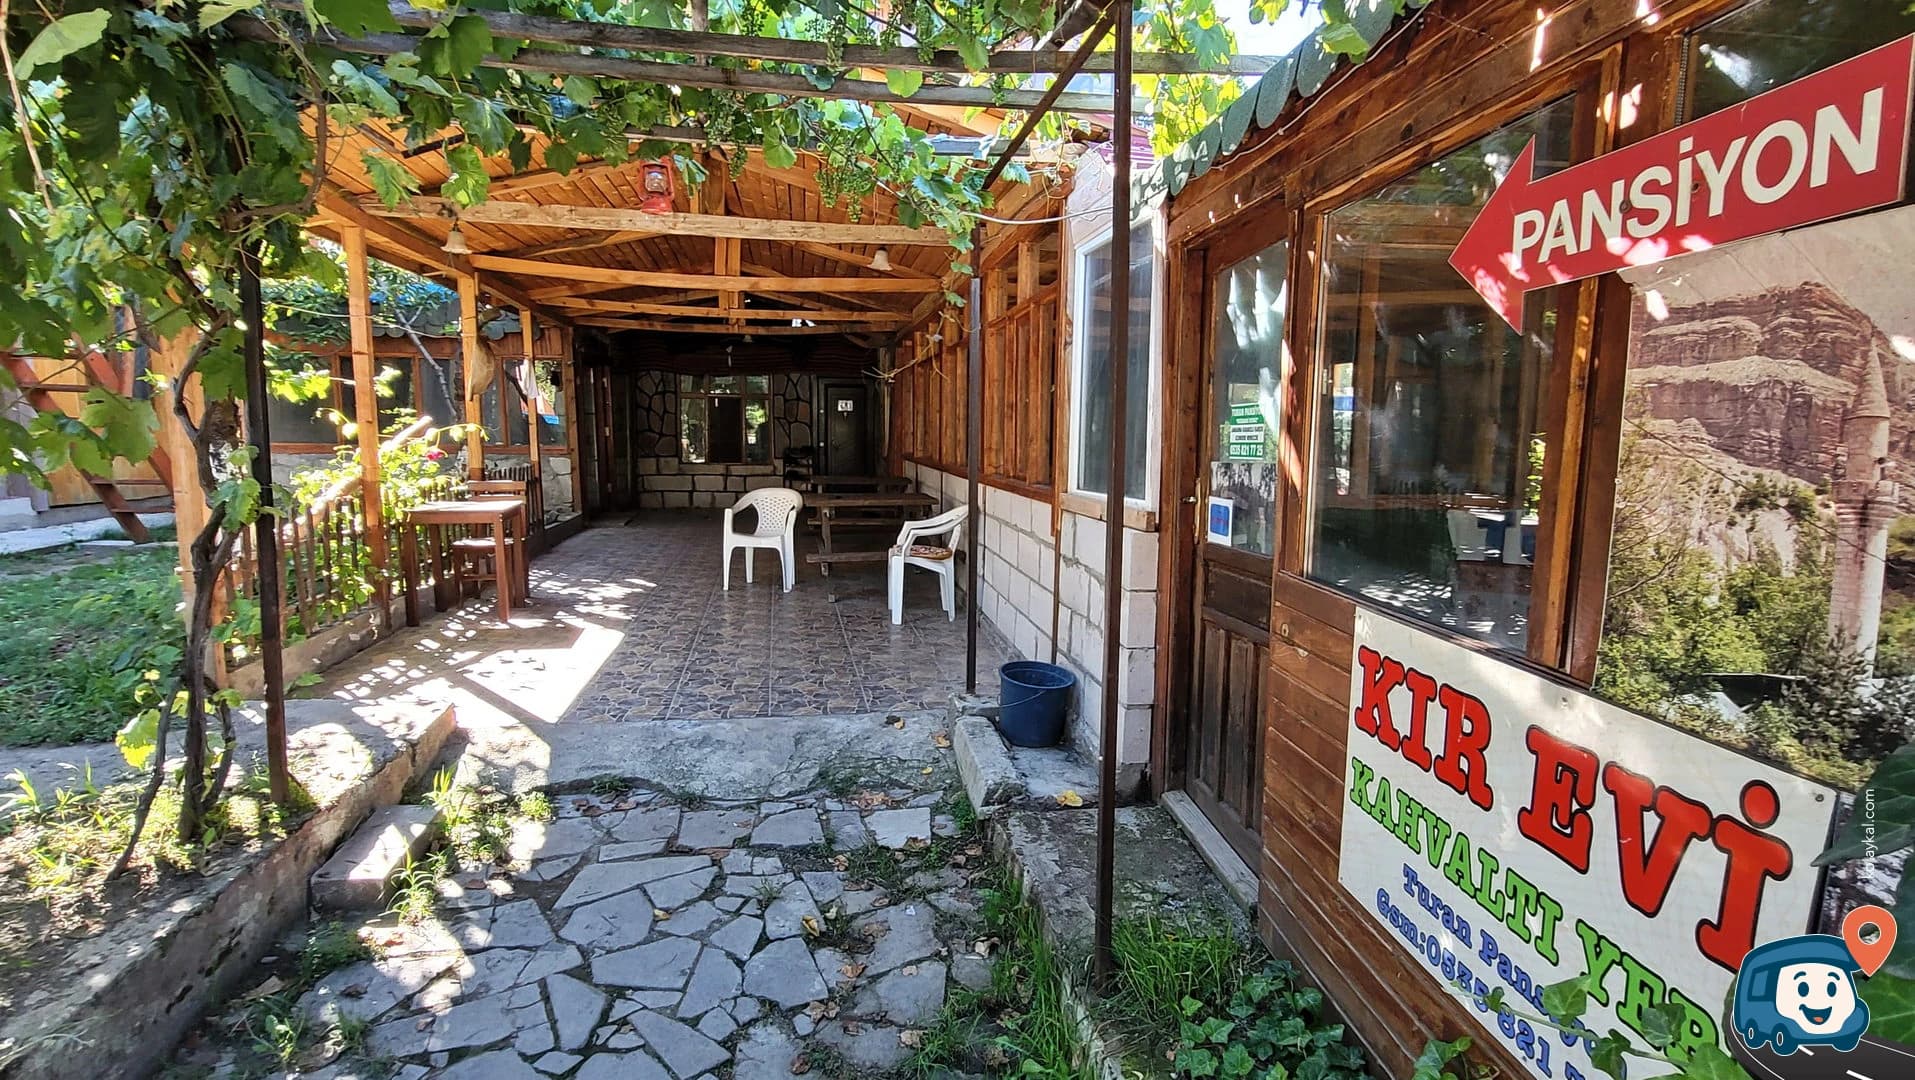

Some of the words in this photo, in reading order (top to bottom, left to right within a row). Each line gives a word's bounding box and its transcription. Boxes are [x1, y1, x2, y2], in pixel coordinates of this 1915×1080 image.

[1511, 87, 1884, 270] PANSİYON
[1350, 757, 1562, 966] KAHVALTI
[1354, 645, 1493, 810] KIR
[1517, 725, 1792, 974] EVİ
[1402, 863, 1472, 949] Turan
[1497, 1002, 1552, 1078] 821
